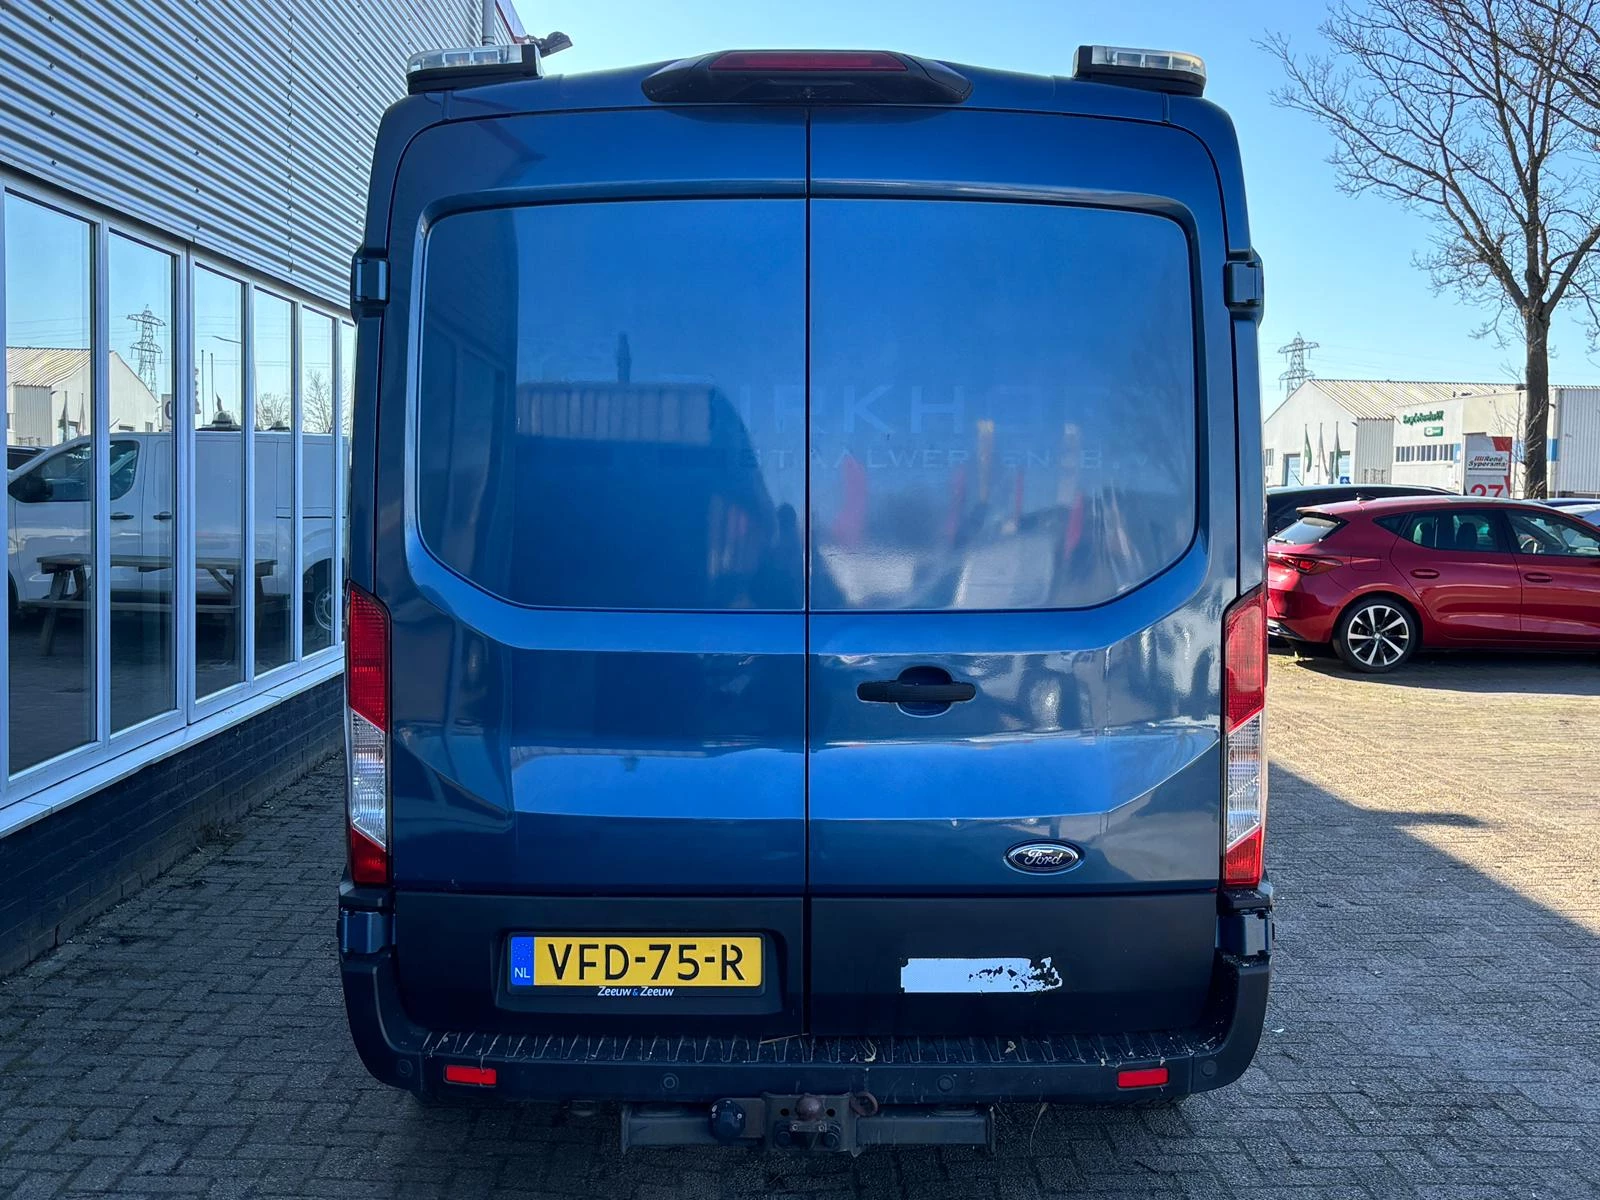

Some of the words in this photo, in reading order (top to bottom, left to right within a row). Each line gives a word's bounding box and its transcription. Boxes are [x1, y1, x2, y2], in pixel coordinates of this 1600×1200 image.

[1470, 483, 1504, 498] 27
[1024, 849, 1063, 865] Ford
[547, 943, 745, 980] VFD-75-R
[514, 967, 531, 979] NL
[597, 985, 632, 997] Zeeuw
[632, 988, 639, 997] &
[639, 985, 675, 997] Zeeuw
